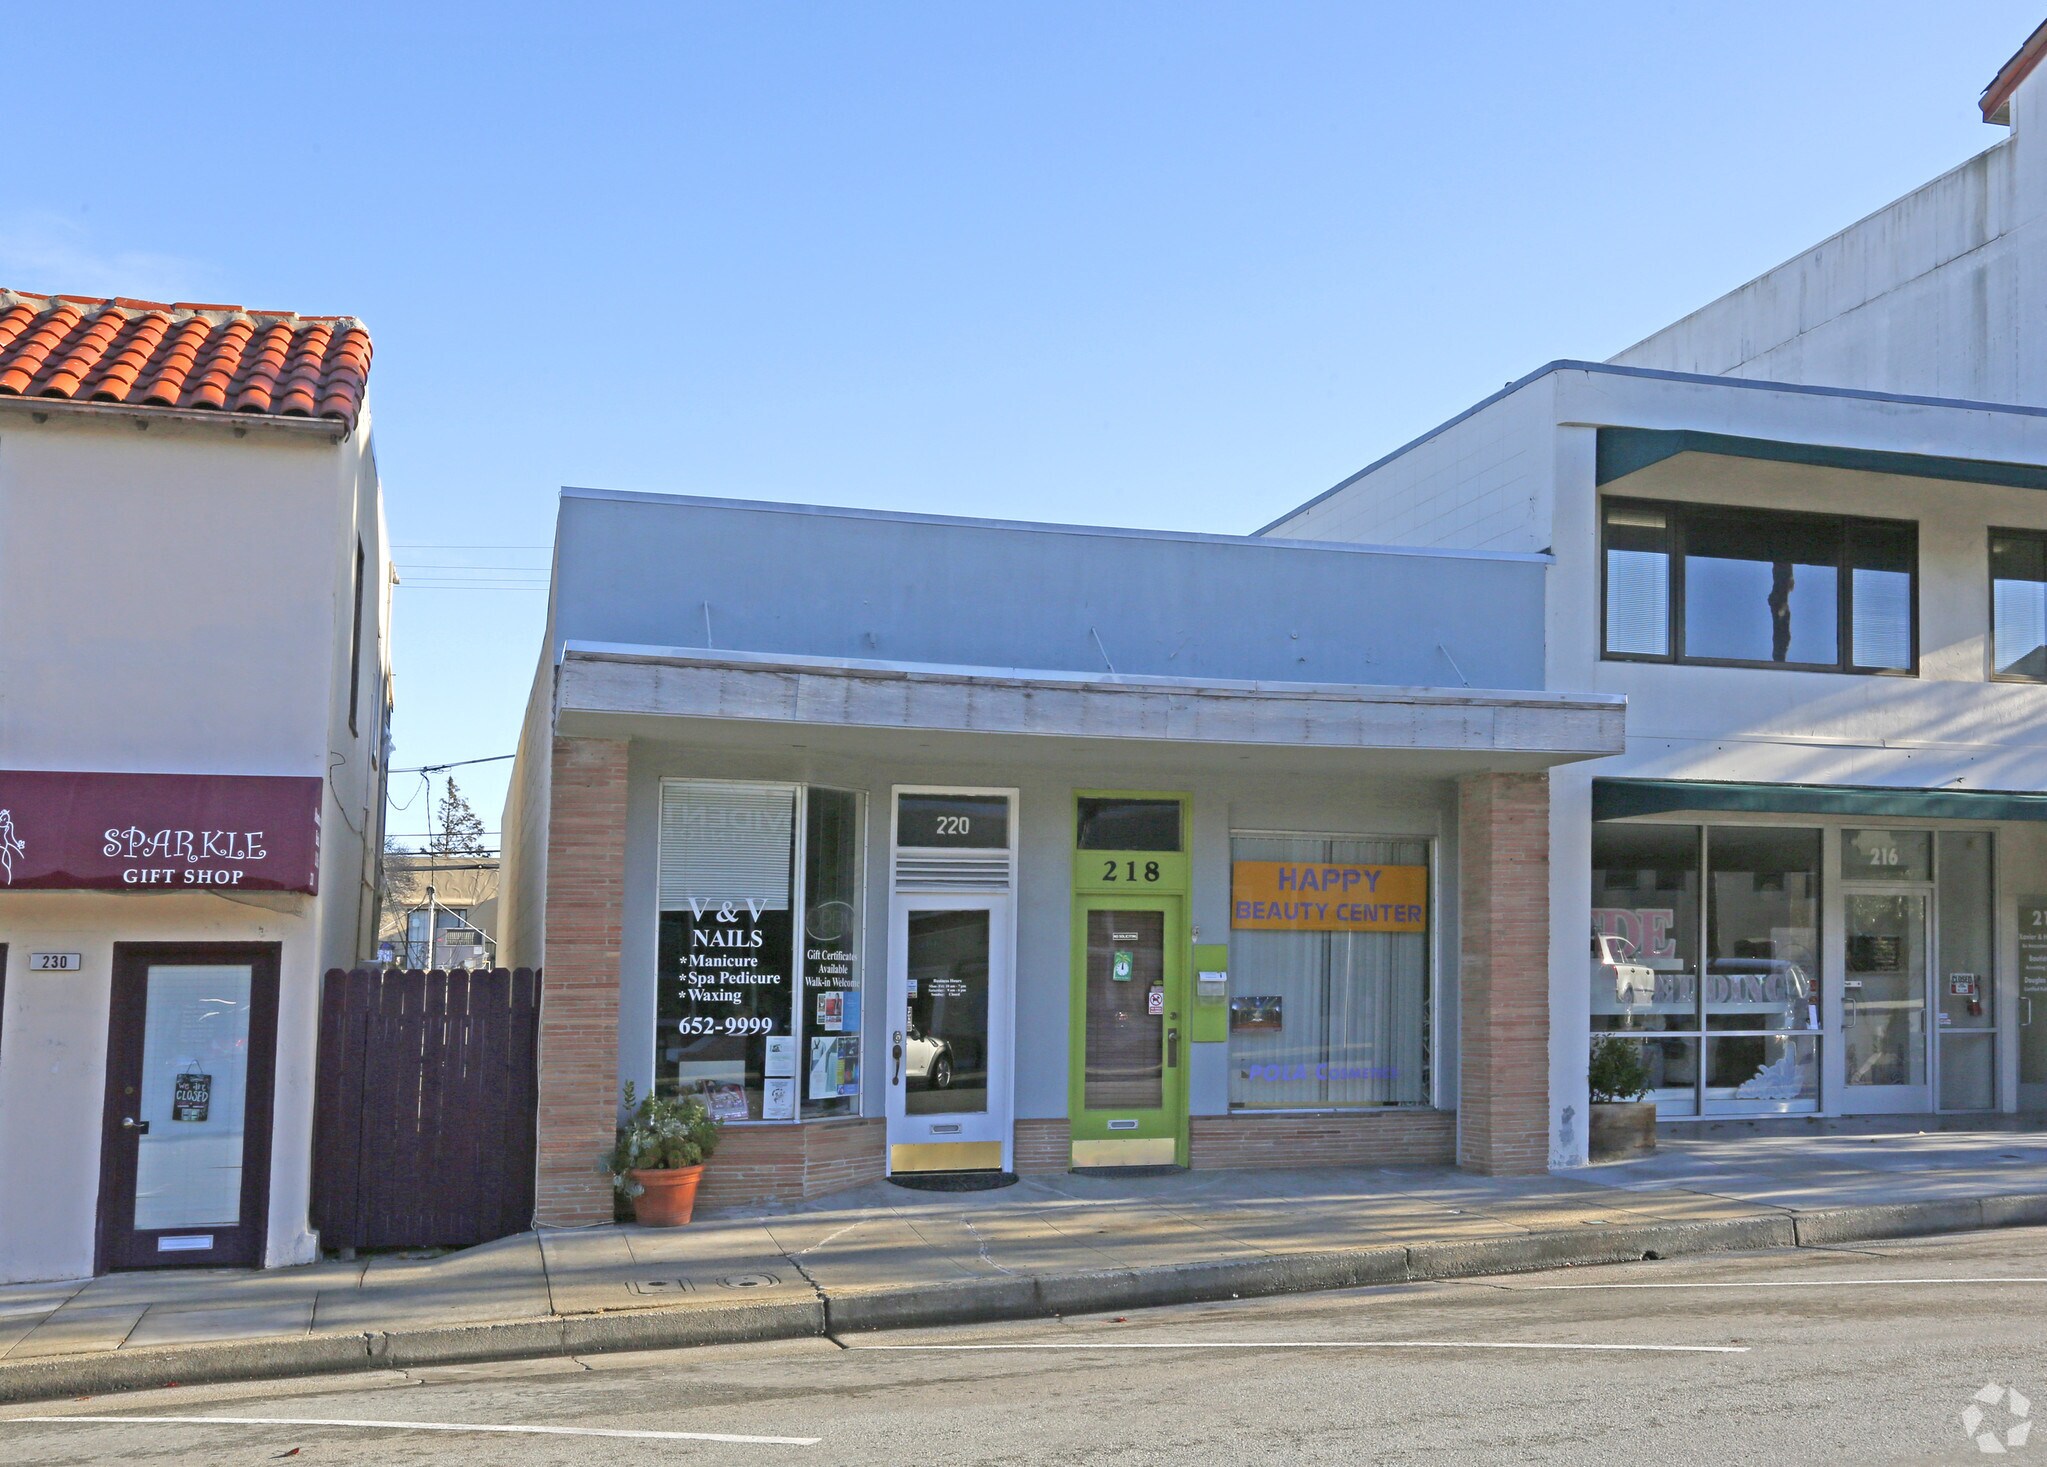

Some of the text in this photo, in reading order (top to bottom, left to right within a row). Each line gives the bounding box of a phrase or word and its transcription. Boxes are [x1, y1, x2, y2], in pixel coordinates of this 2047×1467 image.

[936, 816, 970, 834] 220
[103, 826, 267, 863] SPARKLE
[1870, 847, 1899, 865] 216
[123, 868, 244, 885] GIFT SHOP
[1102, 860, 1160, 882] 218
[1278, 867, 1382, 893] HAPPY
[688, 897, 768, 923] V & V
[1235, 901, 1422, 923] BEAUTY CENTER
[692, 929, 763, 948] NAILS
[42, 955, 67, 969] 230
[688, 954, 758, 967] Manicure
[807, 949, 858, 961] Gift Certificates
[818, 963, 848, 974] Available
[688, 971, 781, 987] Spa Pedicure
[805, 976, 860, 988] Walk-in Welcome
[688, 988, 742, 1005] Waxing
[679, 1016, 773, 1036] 652-9999
[1249, 1063, 1307, 1082] POLA
[176, 1090, 209, 1103] CLOSED
